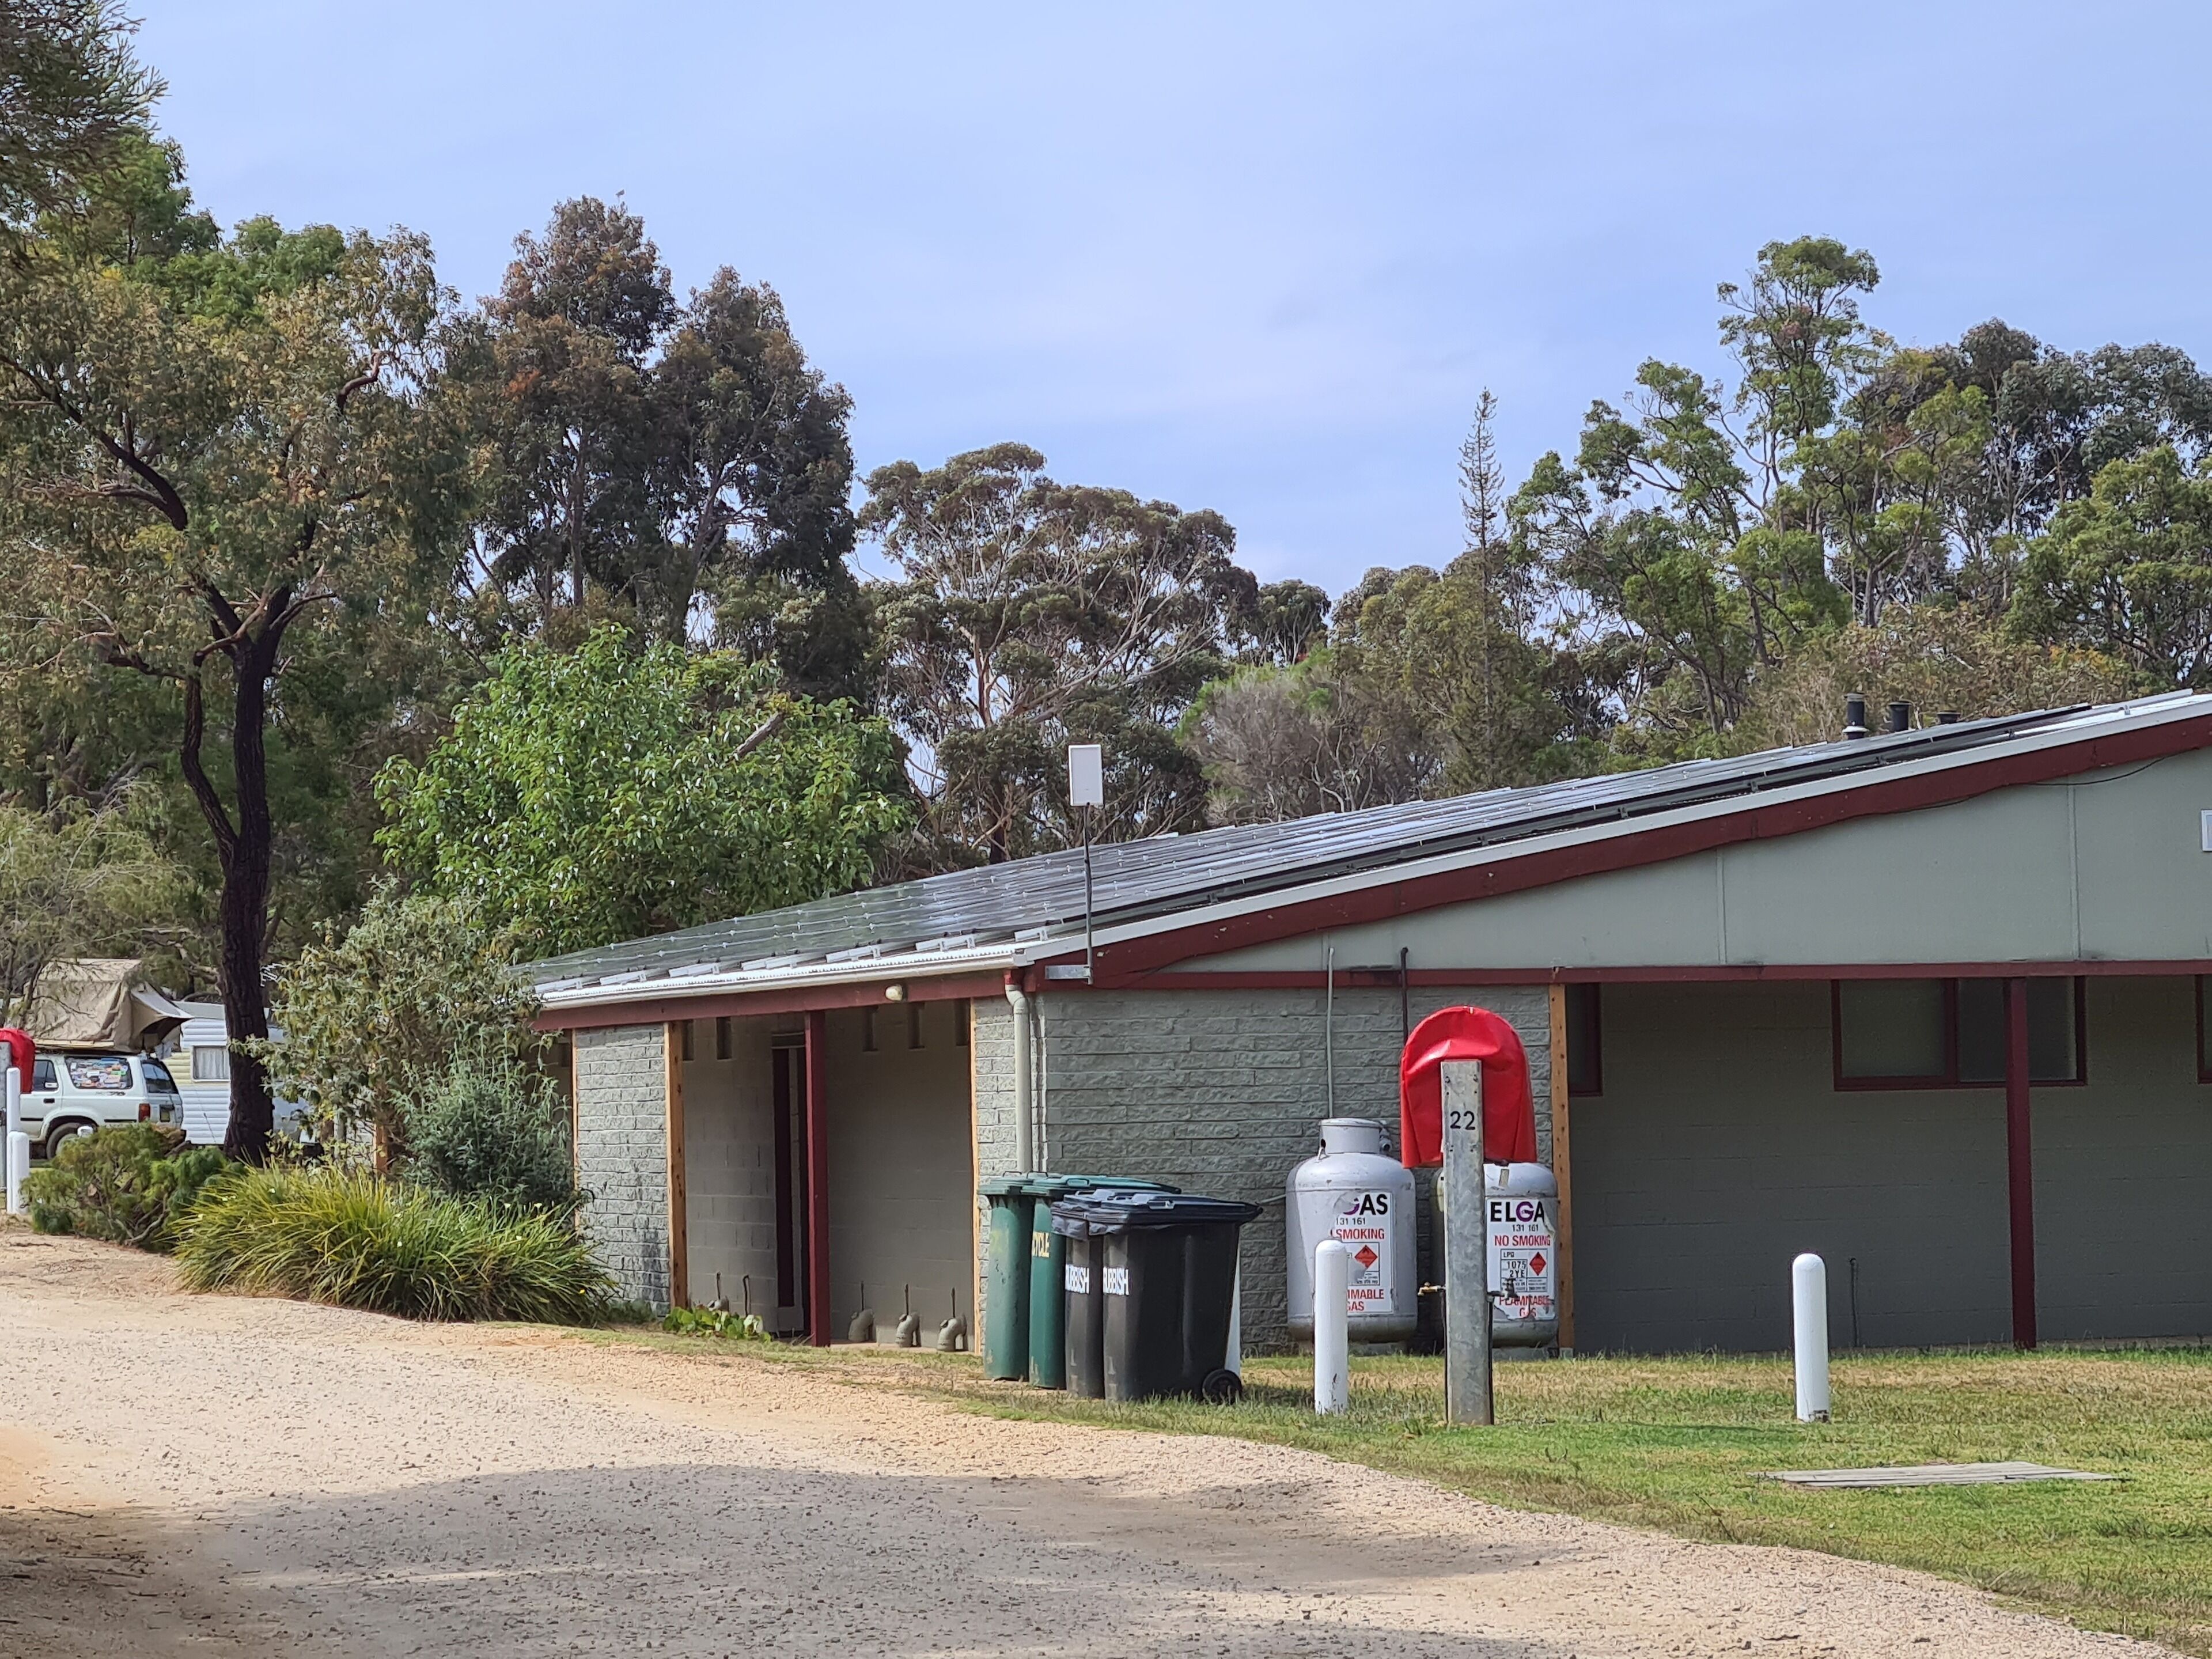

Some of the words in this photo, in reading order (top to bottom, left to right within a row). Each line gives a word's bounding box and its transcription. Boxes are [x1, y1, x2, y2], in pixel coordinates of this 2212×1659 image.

[1450, 1111, 1476, 1130] 22
[1336, 1217, 1349, 1225] 131
[1352, 1217, 1366, 1225] 161
[1513, 1224, 1525, 1232] 131
[1336, 1228, 1385, 1240] SMOKING
[1494, 1234, 1509, 1247] NO
[1512, 1234, 1551, 1247] SMOKING
[1507, 1260, 1526, 1269] 1075
[1510, 1270, 1525, 1278] 2YE
[1103, 1266, 1129, 1296] RUBBISH
[1520, 1307, 1537, 1317] GS
